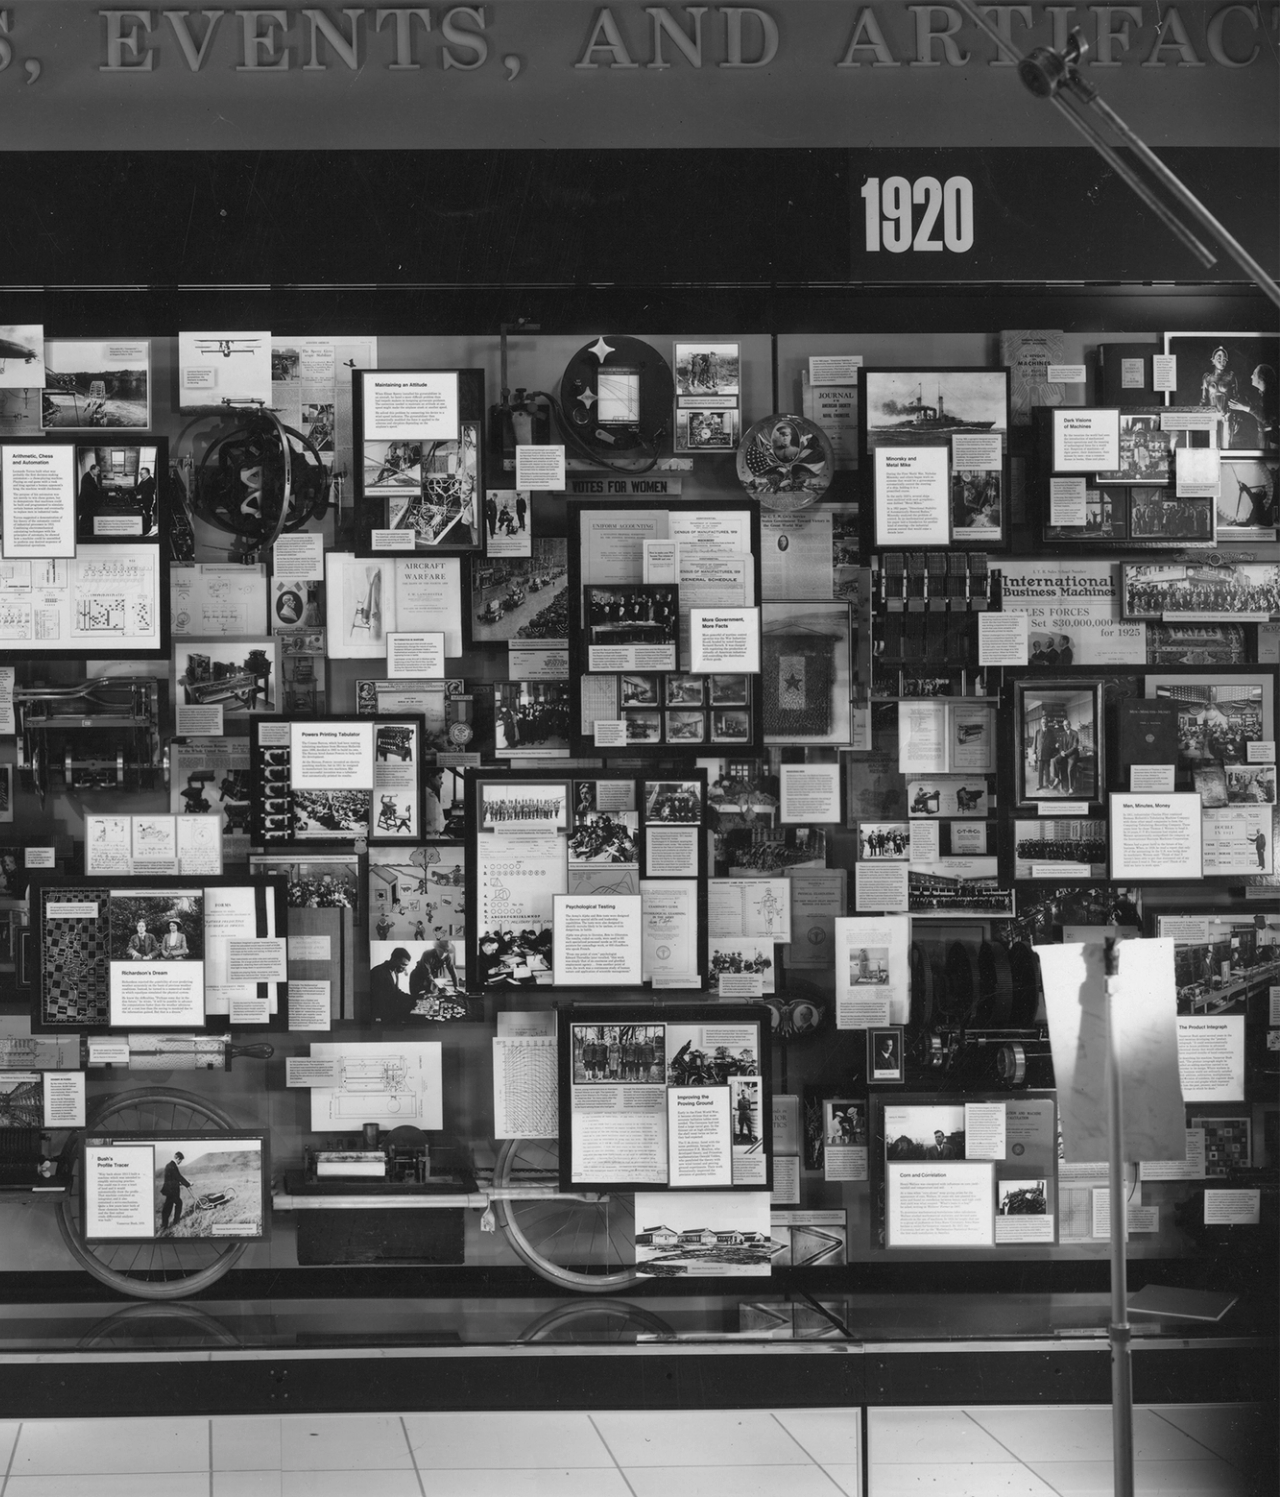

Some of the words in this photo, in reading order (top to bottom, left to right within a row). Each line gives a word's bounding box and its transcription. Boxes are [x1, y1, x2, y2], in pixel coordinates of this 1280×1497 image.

[99, 7, 522, 82] EVENTS,
[574, 7, 780, 70] AND
[836, 5, 1280, 70] ARTIFAC
[861, 175, 974, 254] 1920
[572, 480, 604, 493] VOTES
[607, 480, 627, 493] FOR
[630, 480, 668, 493] WOMEN
[1002, 575, 1116, 587] International
[1002, 587, 1057, 597] Business
[1060, 587, 1116, 597] Machines
[1049, 608, 1090, 617] FORCES
[1031, 618, 1047, 628] Set
[1052, 618, 1113, 628] $30,000,000
[1100, 628, 1114, 637] for
[1118, 628, 1141, 637] 1925
[1173, 627, 1219, 637] PRIZES
